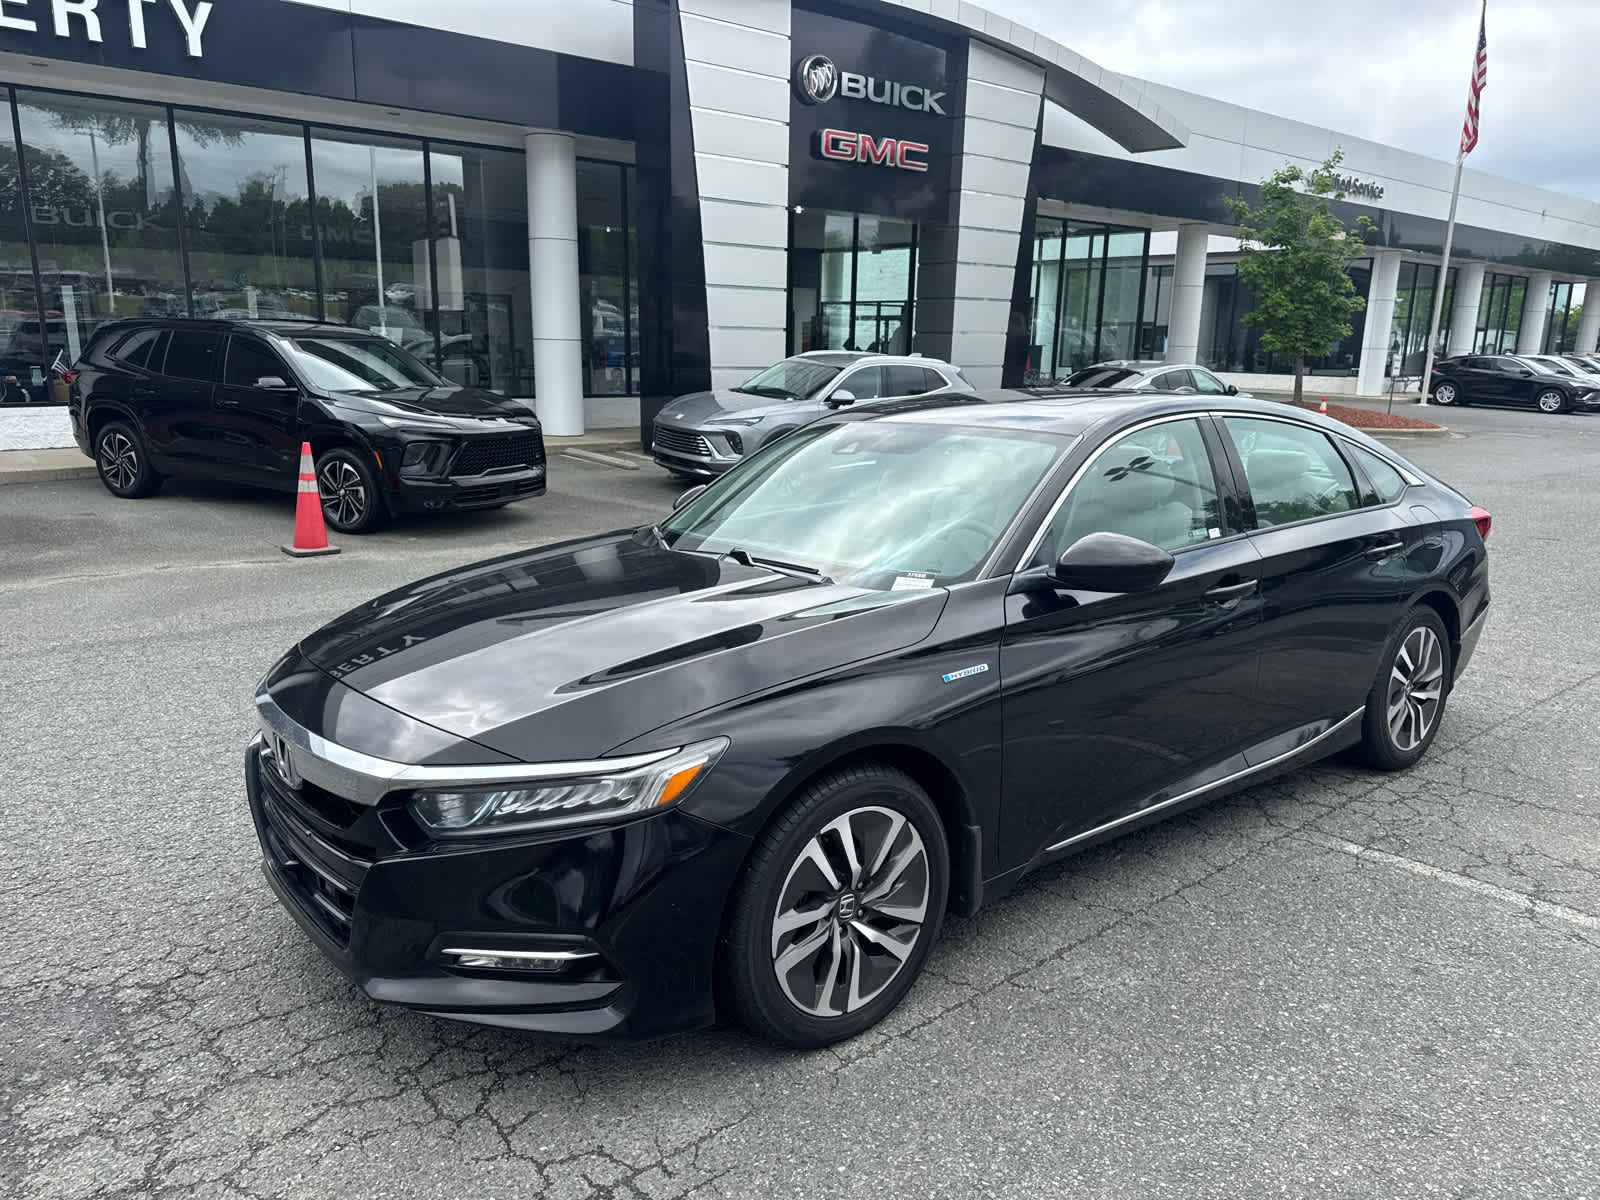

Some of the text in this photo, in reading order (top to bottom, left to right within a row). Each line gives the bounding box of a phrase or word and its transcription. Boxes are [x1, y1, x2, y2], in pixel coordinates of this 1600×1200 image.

[841, 71, 946, 115] BUICK
[821, 128, 928, 172] GMC
[1352, 177, 1385, 199] Service
[949, 664, 987, 681] HYBRID
